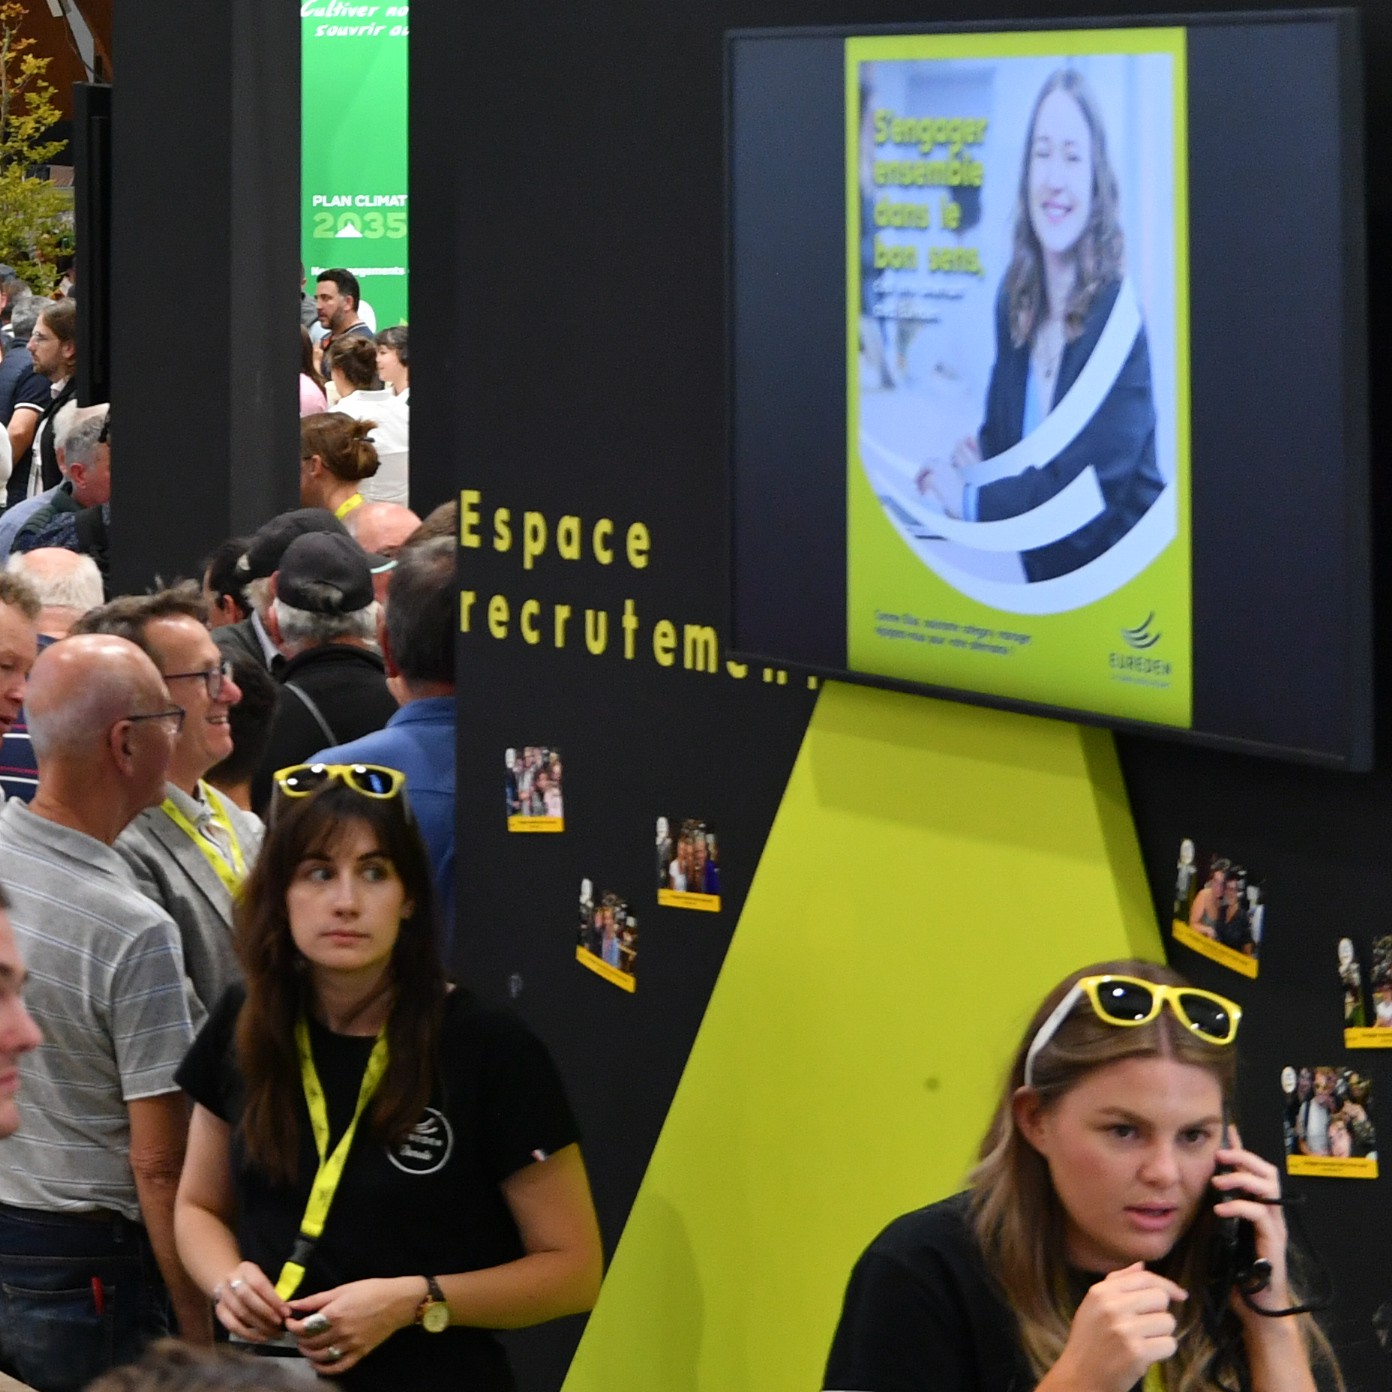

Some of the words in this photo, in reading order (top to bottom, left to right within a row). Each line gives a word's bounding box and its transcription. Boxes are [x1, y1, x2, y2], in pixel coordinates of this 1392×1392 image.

[312, 194, 352, 207] PLAN
[354, 194, 408, 207] CLIMAT
[312, 212, 408, 239] 2035
[460, 489, 652, 570] Espace
